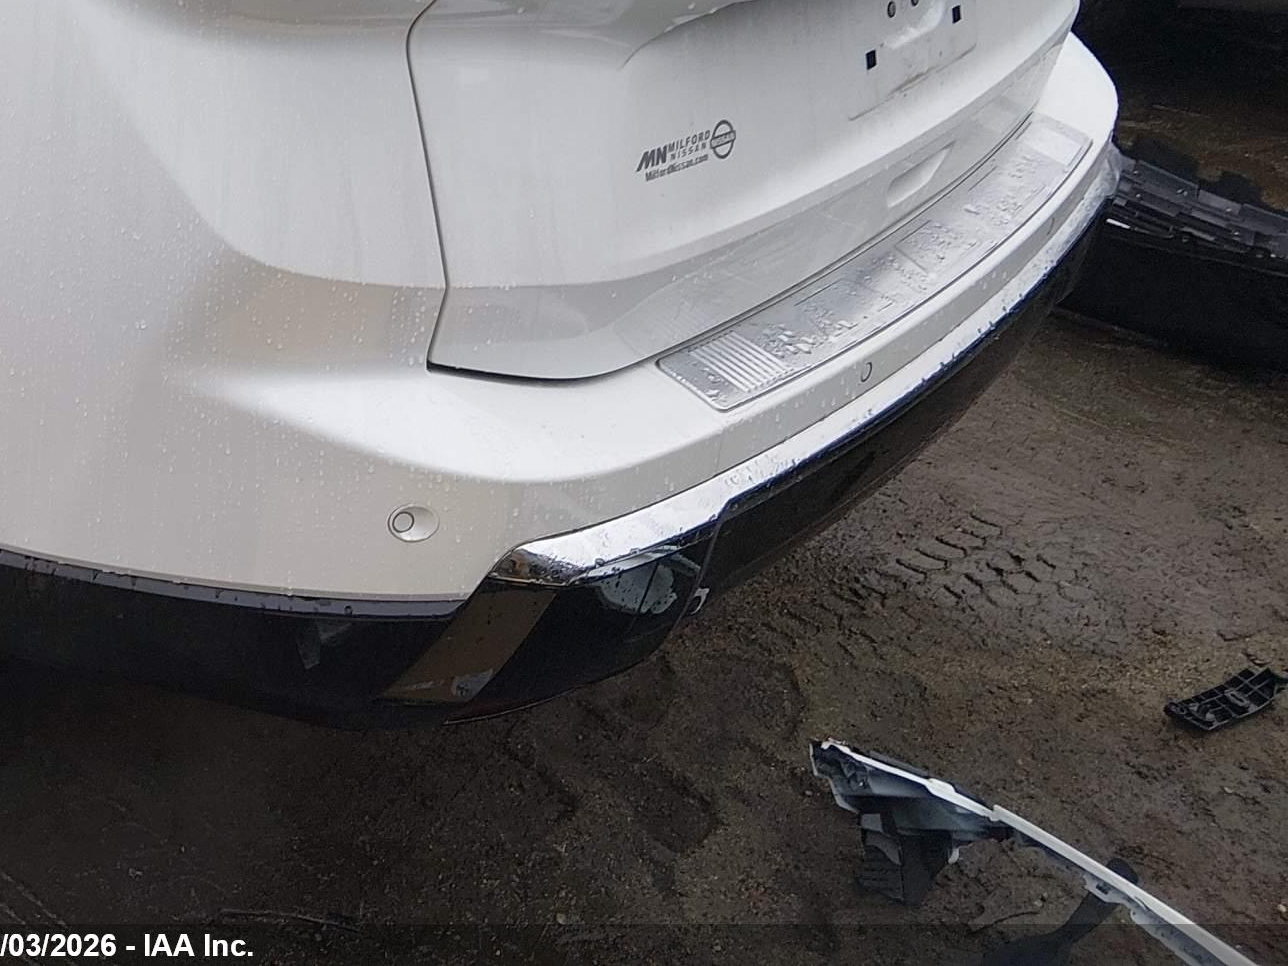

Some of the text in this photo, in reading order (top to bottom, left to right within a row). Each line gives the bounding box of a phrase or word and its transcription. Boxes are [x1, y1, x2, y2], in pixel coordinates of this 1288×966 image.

[668, 130, 710, 152] MILFORD
[671, 142, 707, 160] NISSAN
[636, 144, 667, 172] MN
